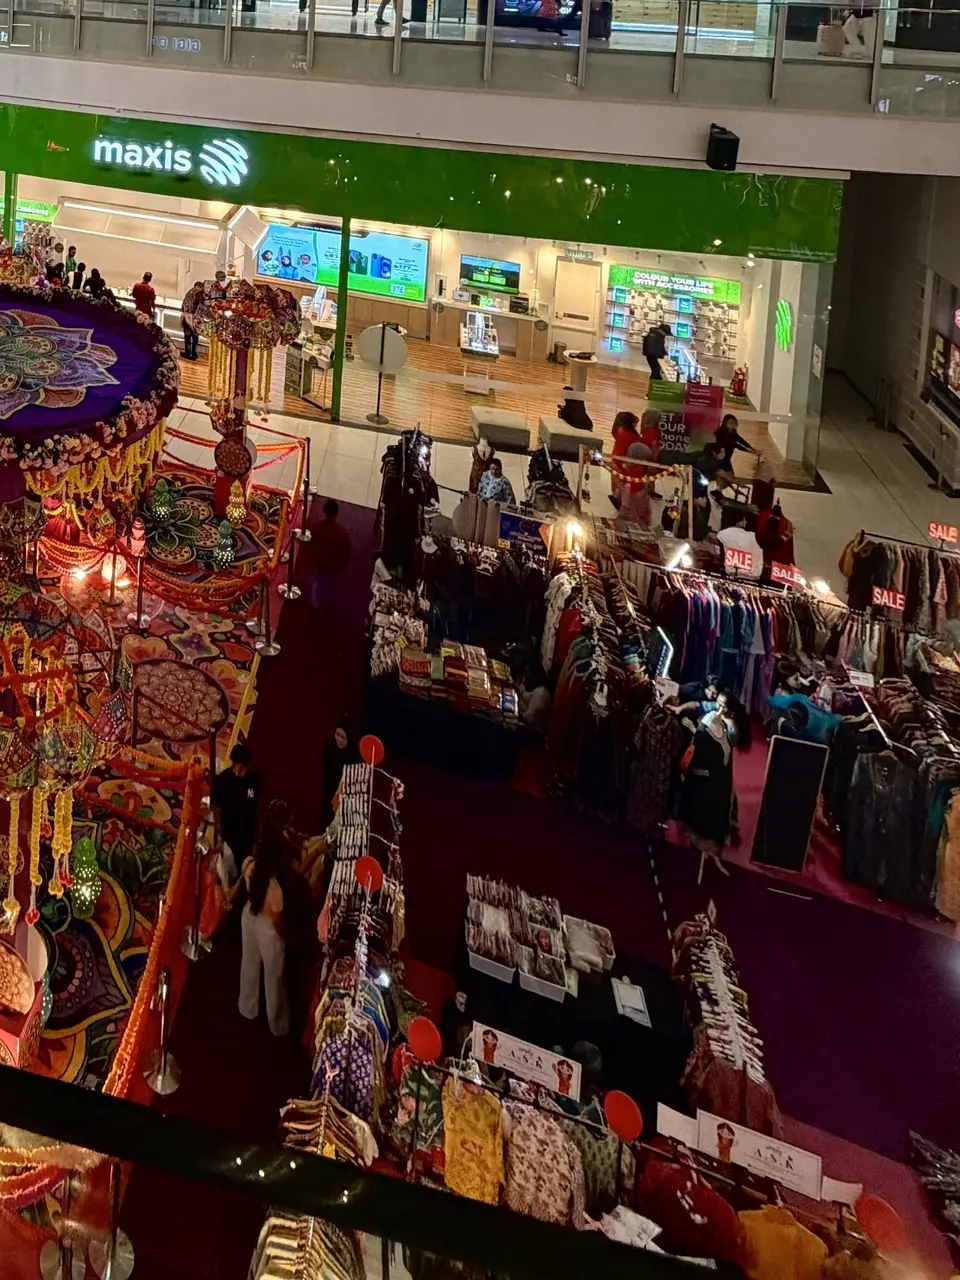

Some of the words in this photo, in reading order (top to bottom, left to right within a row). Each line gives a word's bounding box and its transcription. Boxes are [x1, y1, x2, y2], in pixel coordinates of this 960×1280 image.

[92, 137, 192, 174] maxis
[633, 278, 655, 287] WITH
[656, 280, 715, 295] ACCESSORIES
[634, 271, 669, 282] COLOUR
[671, 276, 694, 286] YOUR
[696, 280, 714, 288] LIFE
[929, 524, 957, 542] SALE
[725, 549, 752, 569] SALE
[772, 566, 802, 583] SALE
[873, 588, 905, 610] SALE
